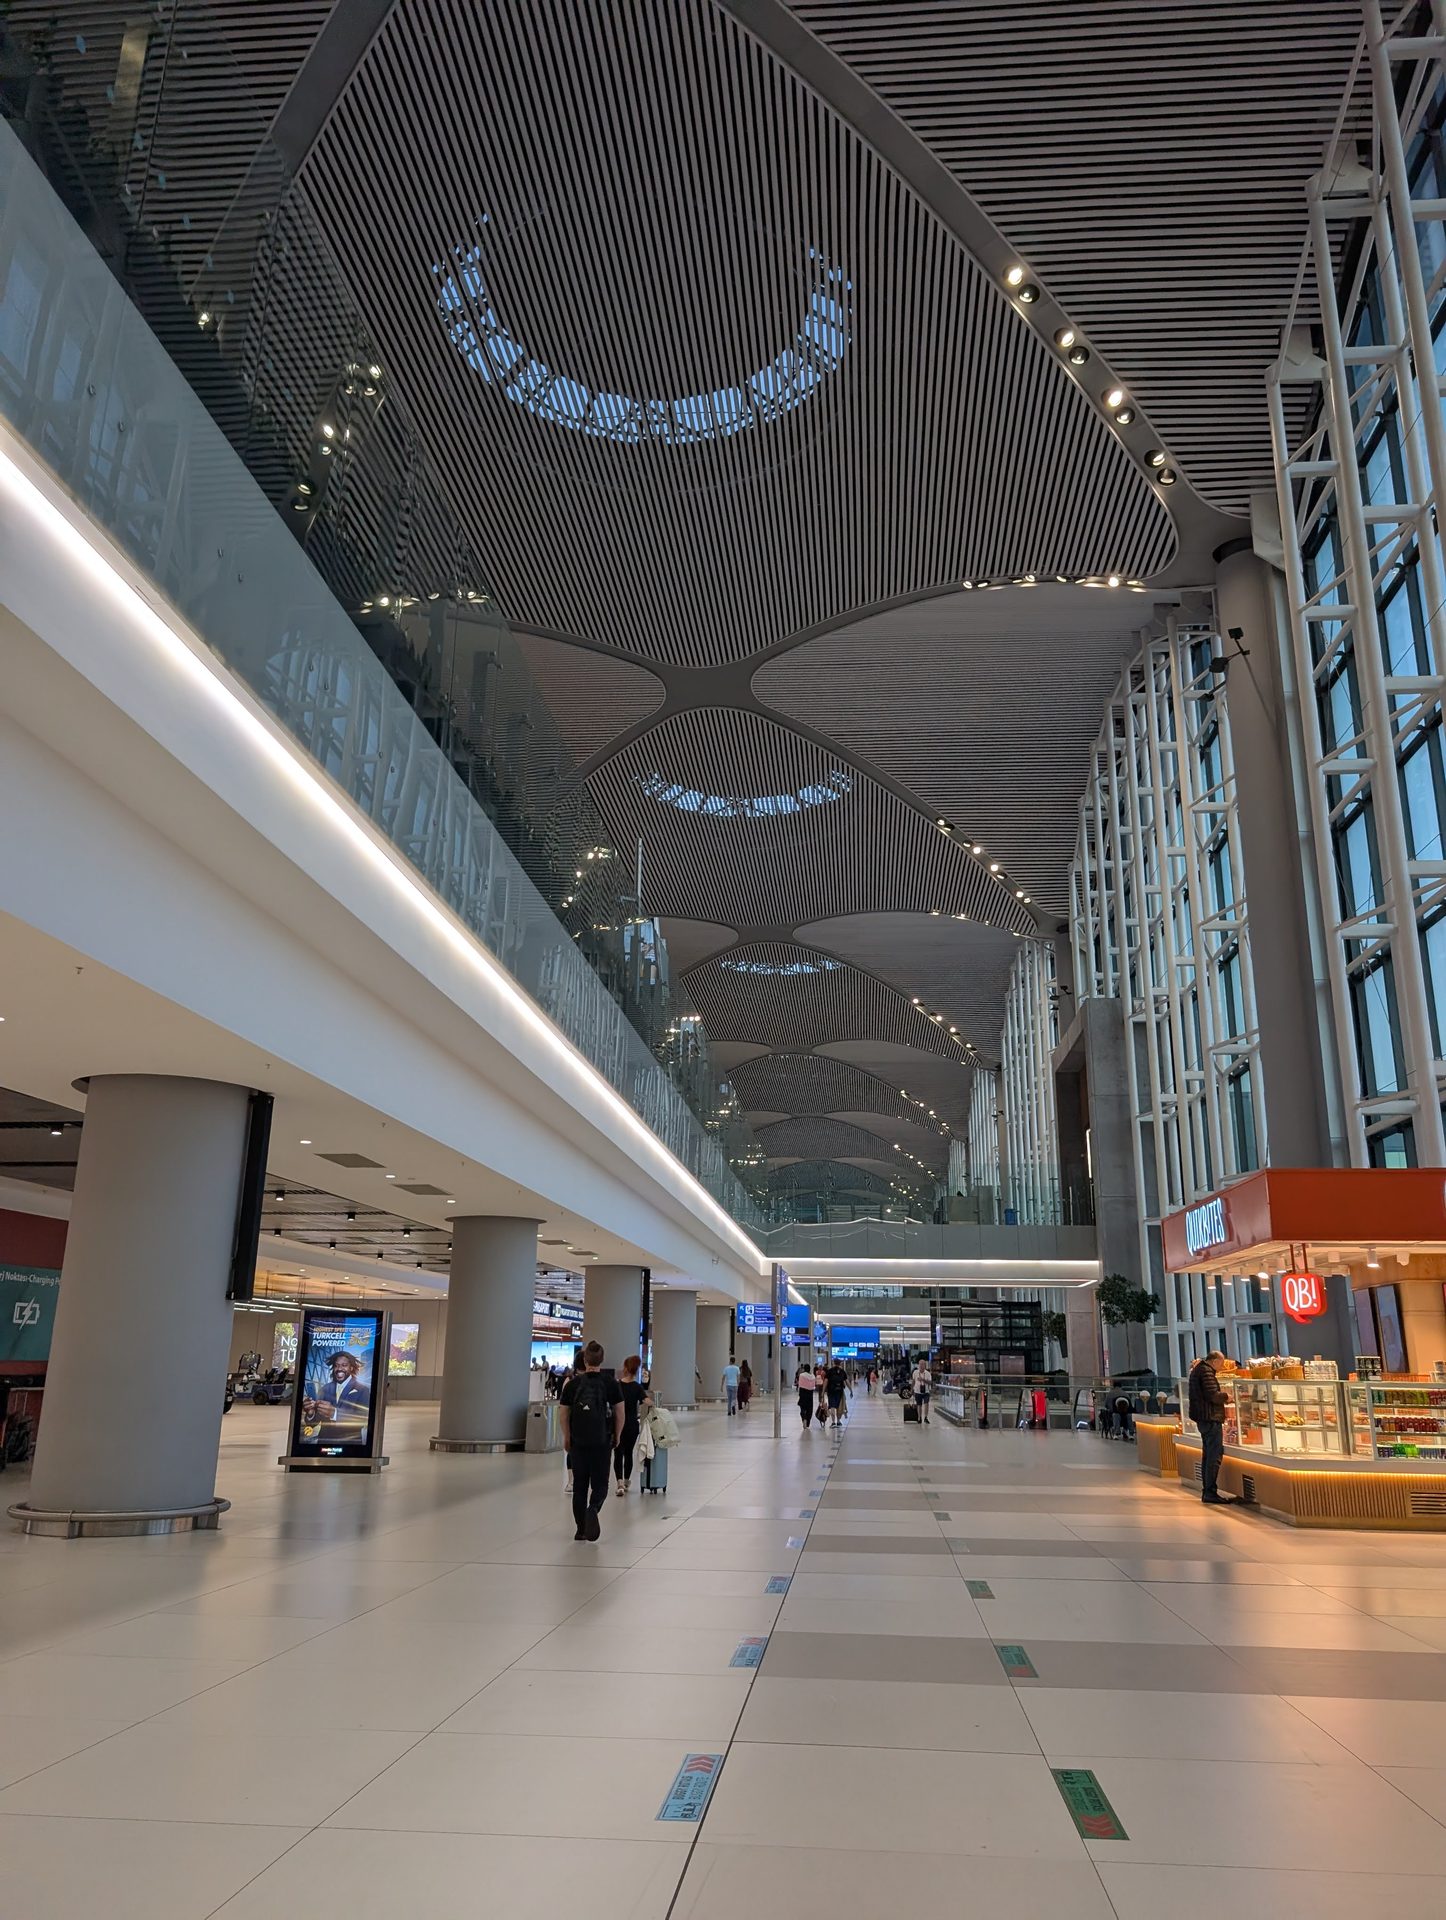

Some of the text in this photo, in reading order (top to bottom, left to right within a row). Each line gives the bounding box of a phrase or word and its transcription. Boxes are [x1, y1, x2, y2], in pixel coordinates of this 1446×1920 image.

[1285, 1277, 1318, 1312] QB!
[313, 1332, 346, 1340] TURKCELL
[312, 1339, 346, 1347] POWERED
